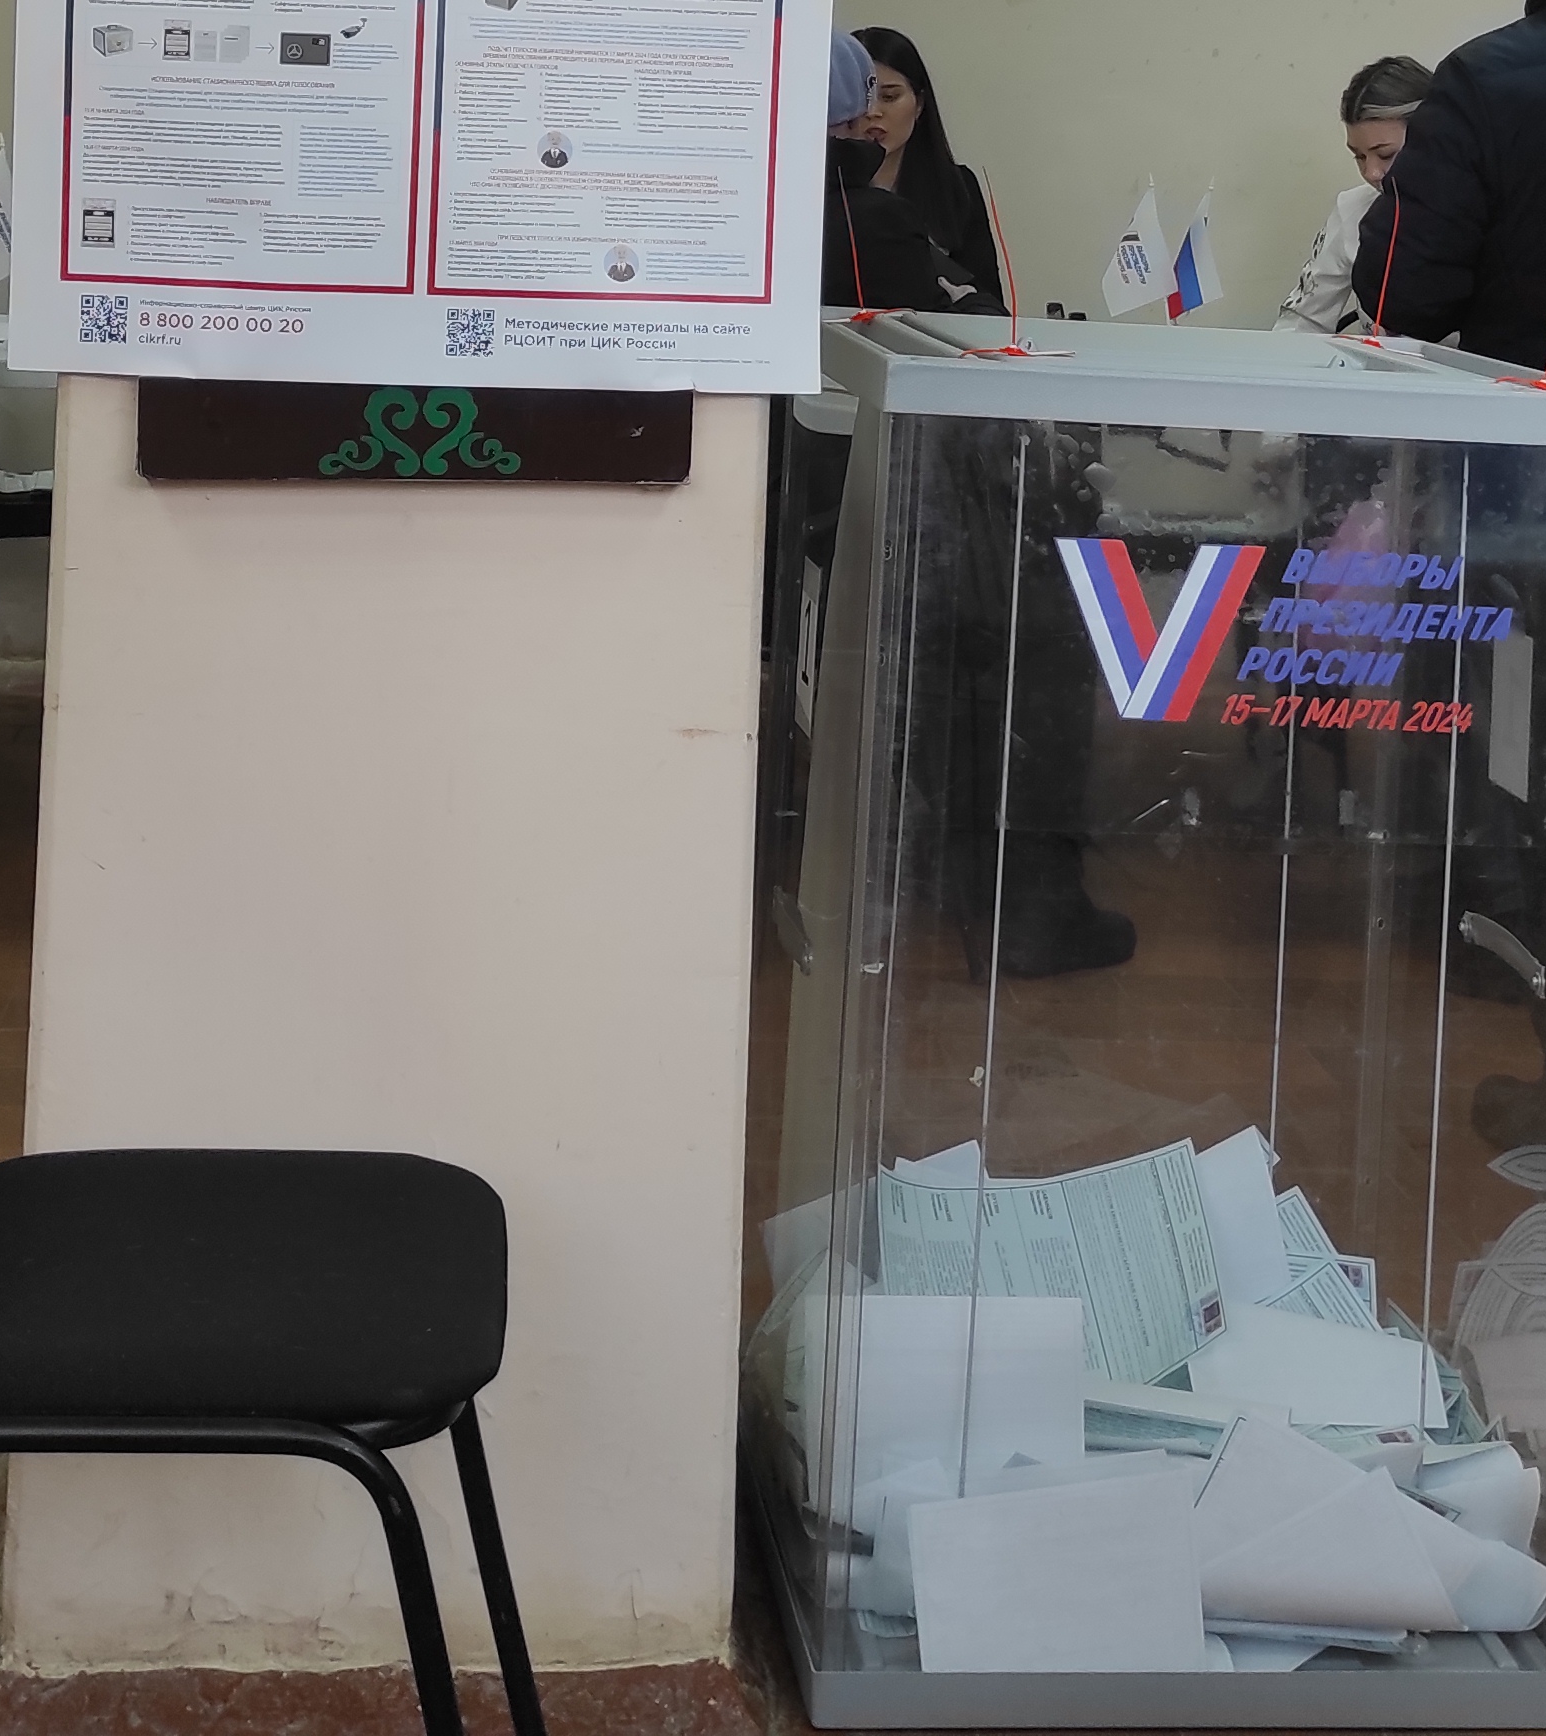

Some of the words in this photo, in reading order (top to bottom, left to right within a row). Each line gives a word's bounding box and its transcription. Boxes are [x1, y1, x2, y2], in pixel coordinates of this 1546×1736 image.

[139, 312, 151, 327] 8
[156, 313, 194, 329] 800
[201, 315, 239, 331] 200
[246, 317, 272, 333] 00
[279, 318, 304, 334] 20
[504, 317, 609, 333] Методические
[613, 320, 690, 335] материалы
[693, 324, 709, 335] на
[712, 323, 751, 335] сайте
[138, 332, 182, 346] cikrf.ru
[504, 334, 555, 350] РЦОИТ
[559, 337, 586, 350] при
[591, 337, 622, 351] ЦИК
[626, 337, 677, 350] России
[1281, 548, 1465, 591] ВЫБОРЫ
[1259, 597, 1514, 642] ПРЕЗИДЕНТА
[1237, 647, 1404, 686] РОССИИ
[1301, 697, 1401, 731] МАРТА
[1402, 700, 1473, 734] 2024
